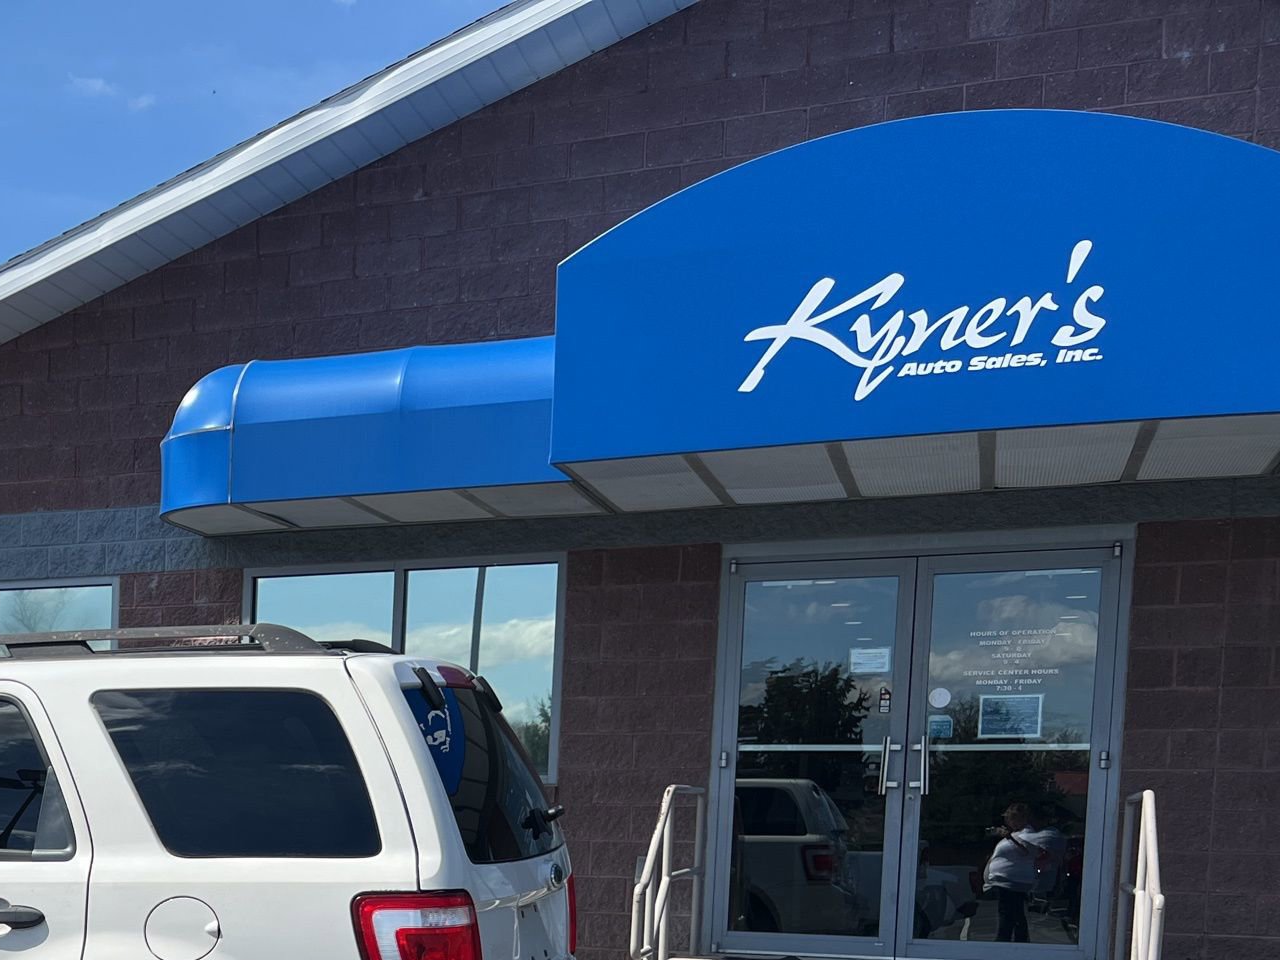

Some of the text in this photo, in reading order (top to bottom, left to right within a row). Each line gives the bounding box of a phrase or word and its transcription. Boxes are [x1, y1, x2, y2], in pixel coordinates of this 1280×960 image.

[737, 239, 1106, 401] Kyner's
[897, 346, 1104, 378] Auto Sales, Inc.
